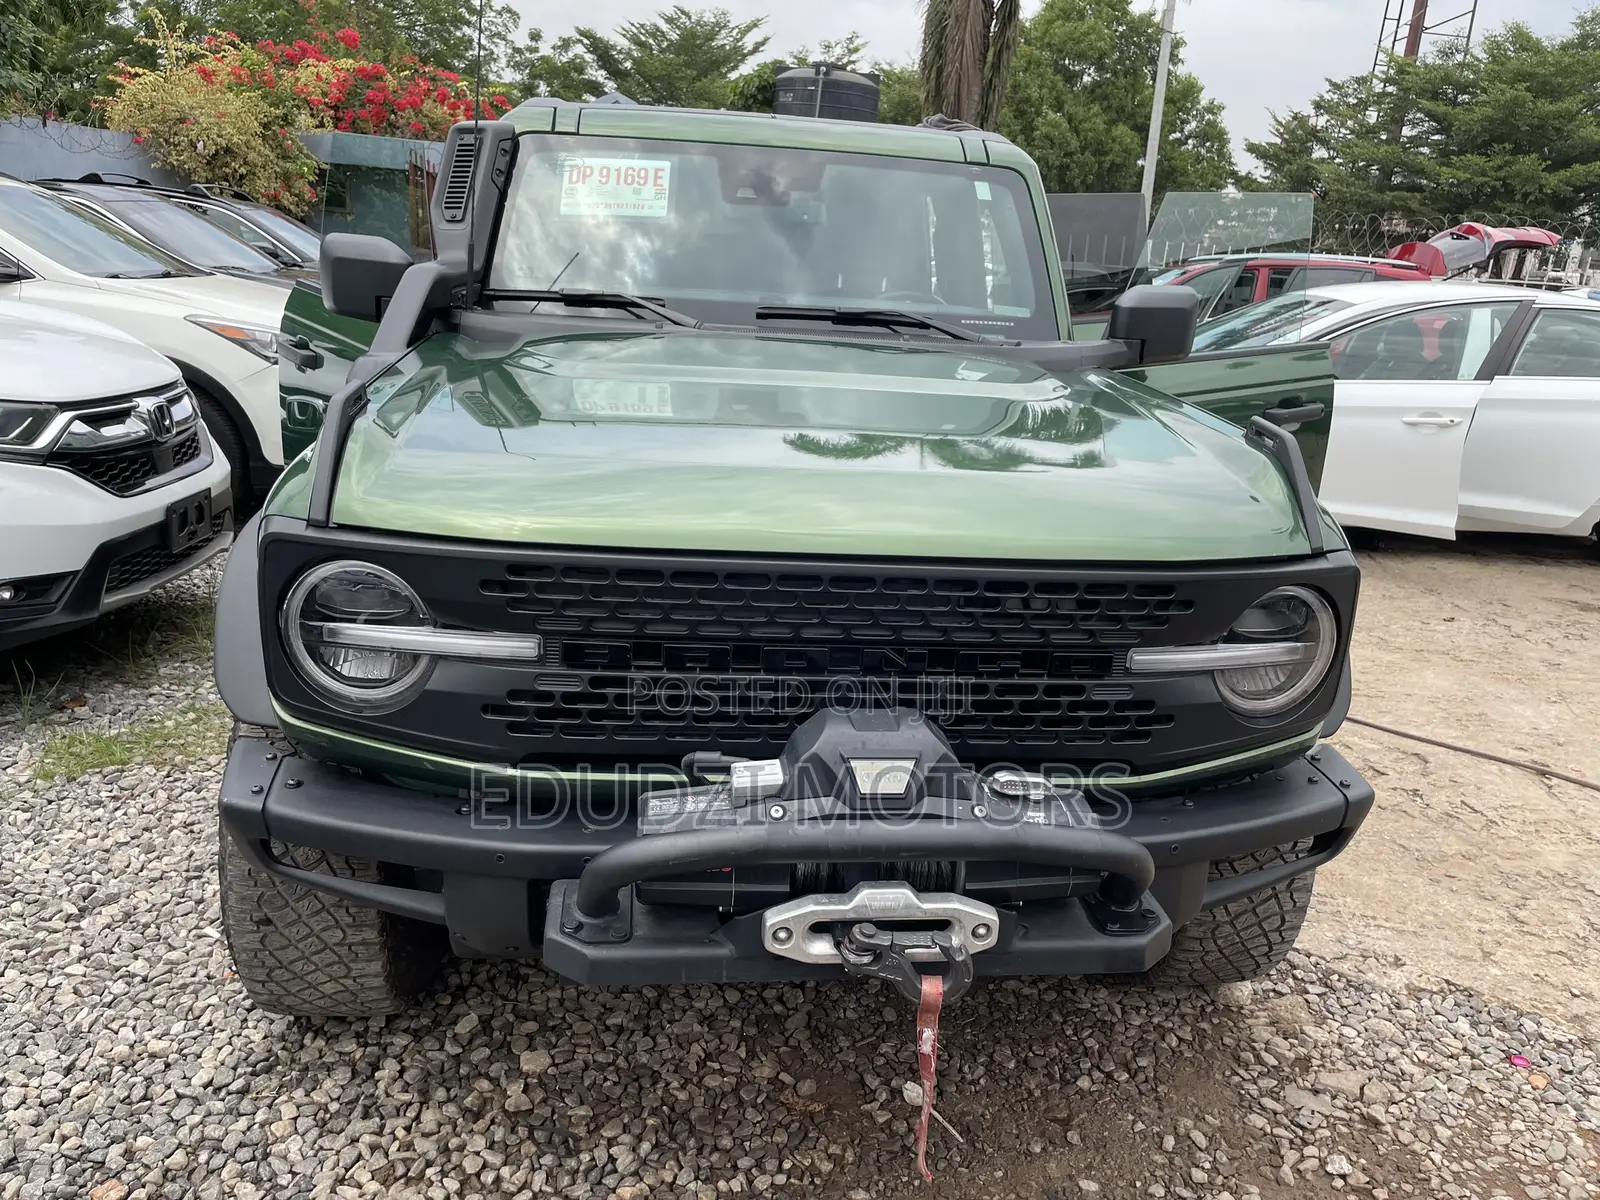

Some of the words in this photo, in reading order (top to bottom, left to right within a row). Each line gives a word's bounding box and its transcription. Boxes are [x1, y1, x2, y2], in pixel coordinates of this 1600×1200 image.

[568, 165, 594, 185] DP
[598, 165, 649, 187] 9169
[653, 168, 665, 187] E
